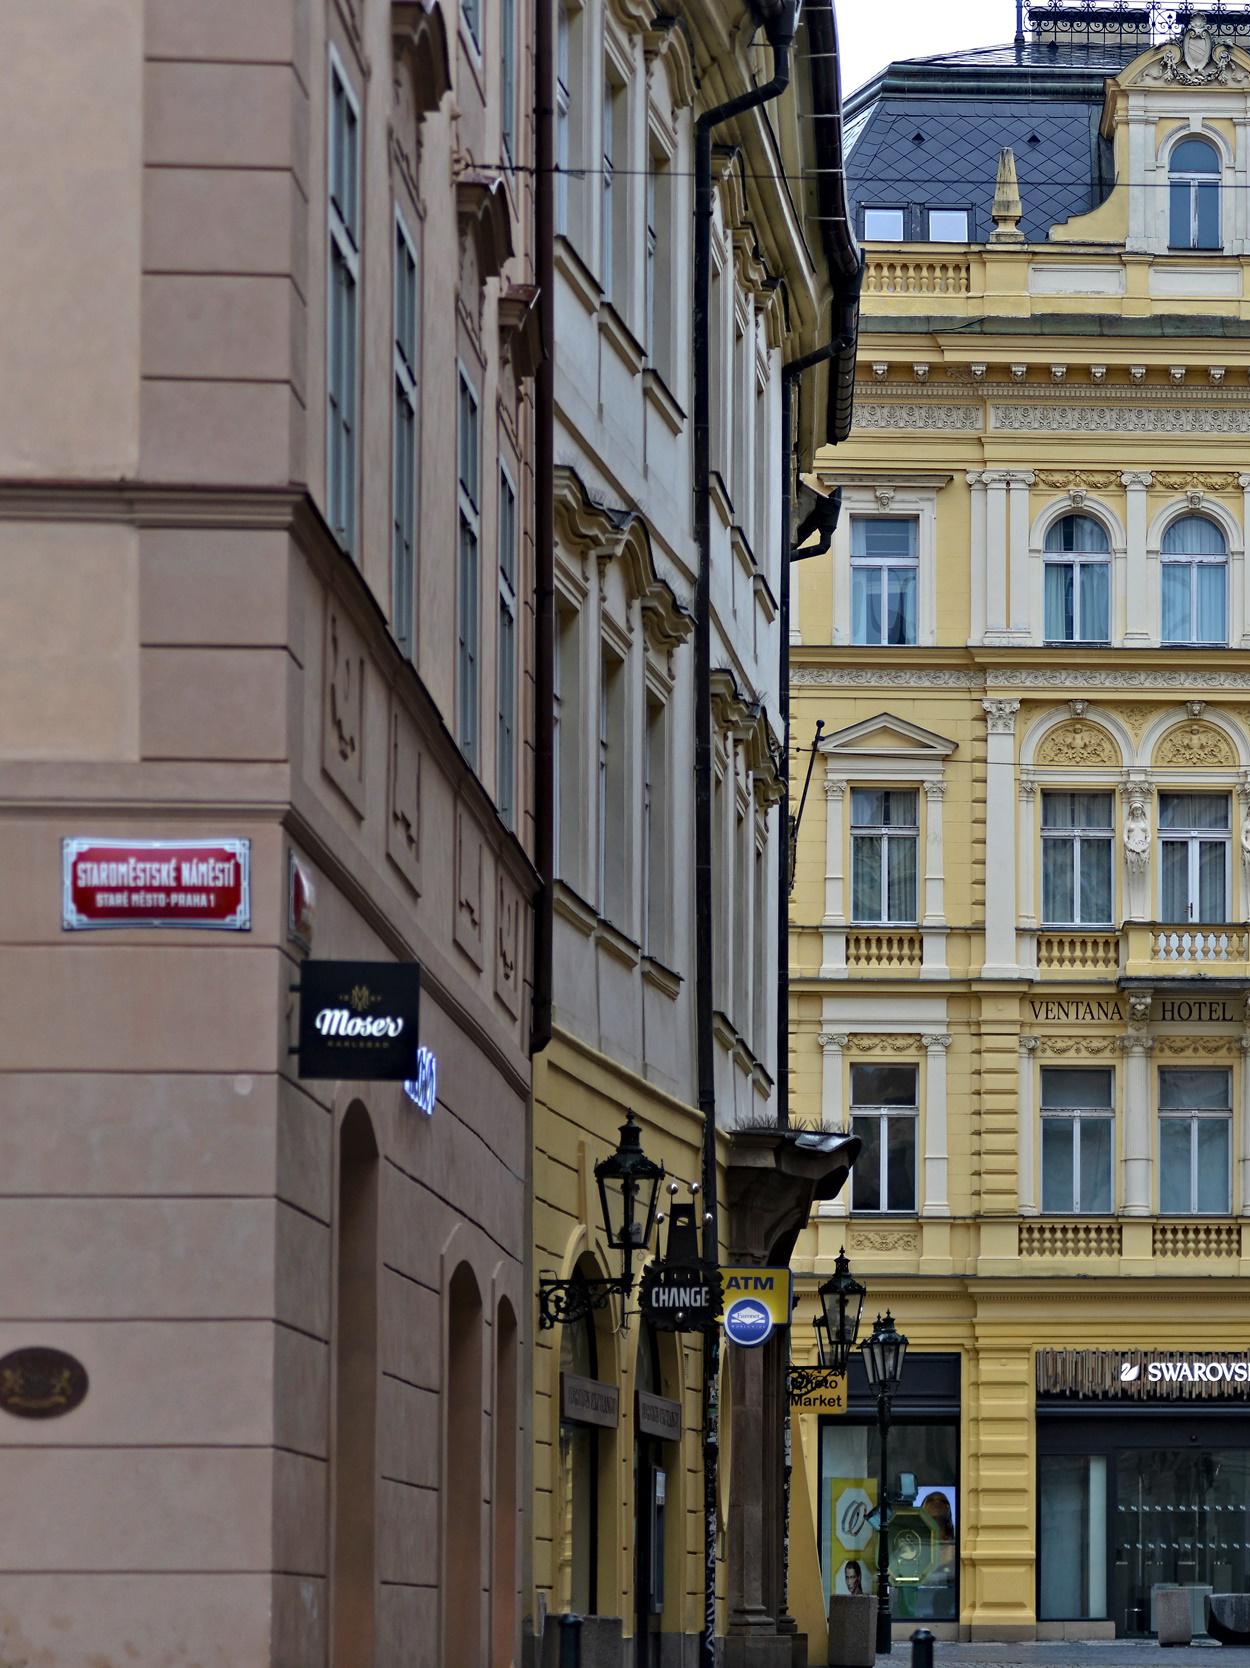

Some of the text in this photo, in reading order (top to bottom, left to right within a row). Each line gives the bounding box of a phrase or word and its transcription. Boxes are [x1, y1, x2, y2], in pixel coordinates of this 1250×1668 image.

[76, 856, 236, 887] STAROMĚSTSKÉ NÁMĚSTÍ
[95, 892, 129, 907] STARÉ
[209, 893, 216, 907] 1
[1030, 1001, 1124, 1021] VENTANA
[1161, 1001, 1234, 1021] HOTEL
[314, 1008, 404, 1037] Moser
[725, 1276, 774, 1290] ATM
[651, 1287, 710, 1308] CHANGE
[790, 1394, 843, 1408] Market
